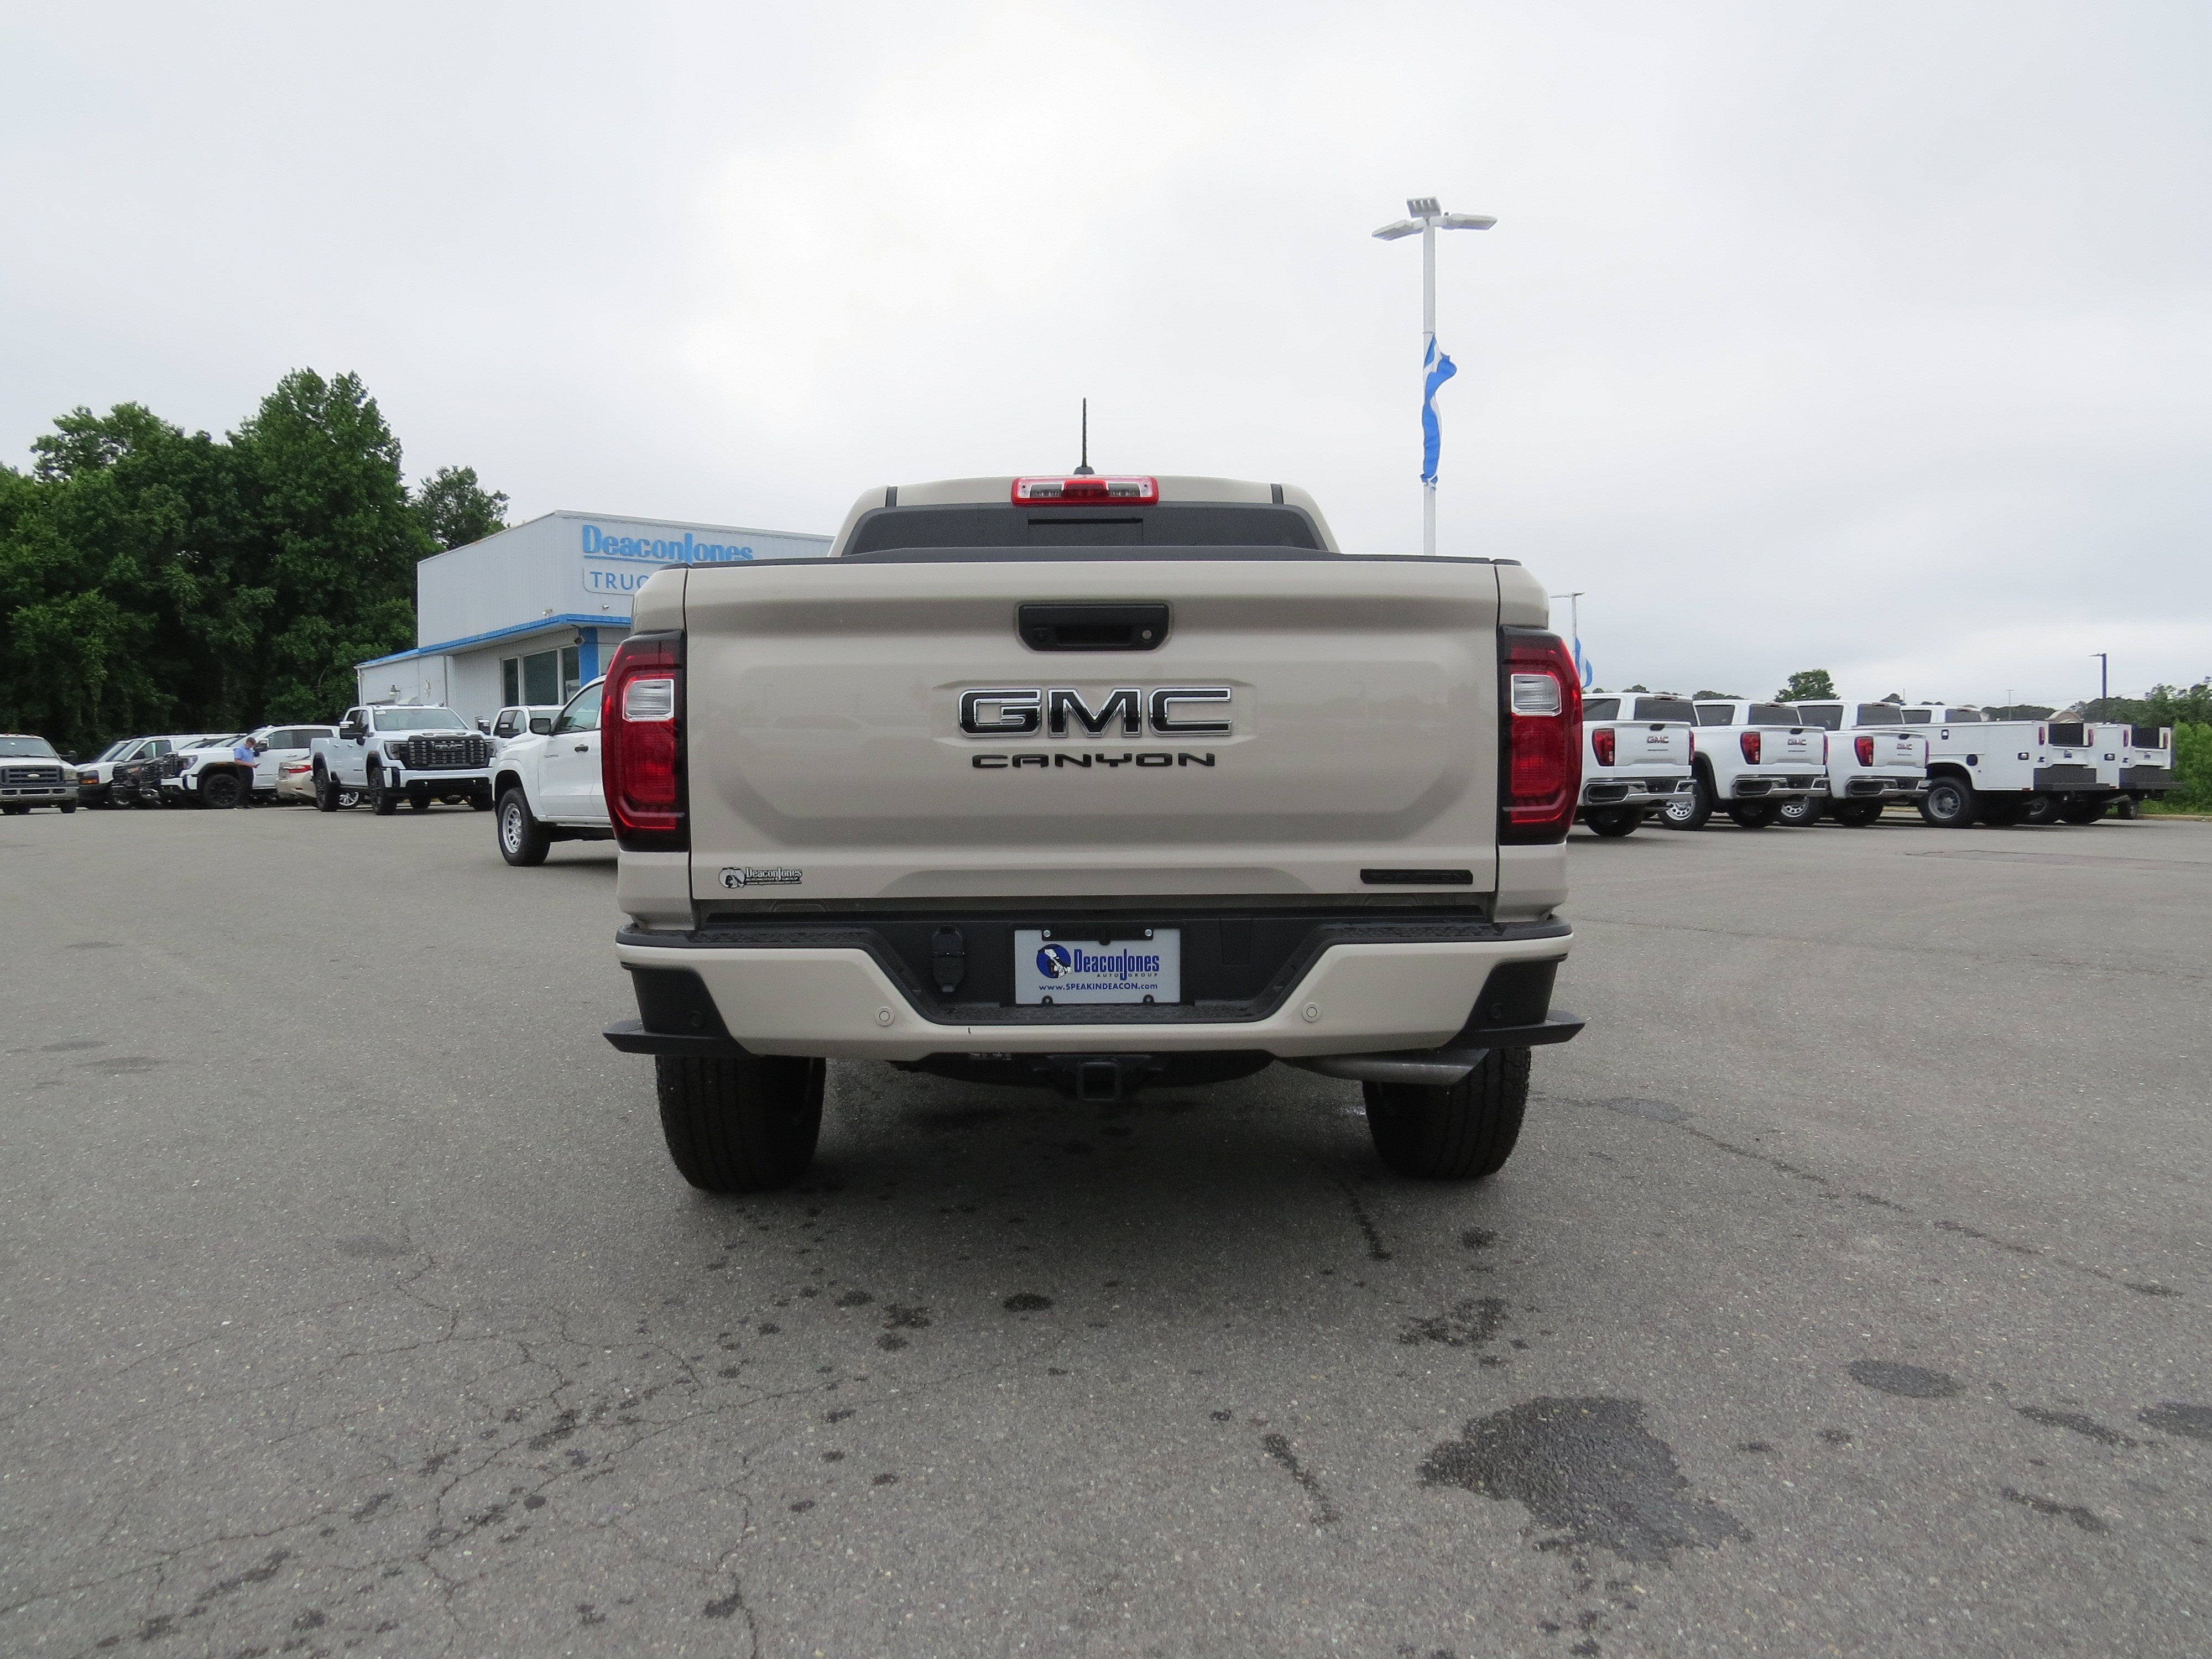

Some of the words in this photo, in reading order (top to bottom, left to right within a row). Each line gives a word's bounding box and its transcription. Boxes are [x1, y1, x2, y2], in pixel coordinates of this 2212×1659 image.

[959, 688, 1232, 738] GMC
[972, 753, 1215, 768] CANYON
[1039, 982, 1158, 990] www.SPEAKINDEACON.com
